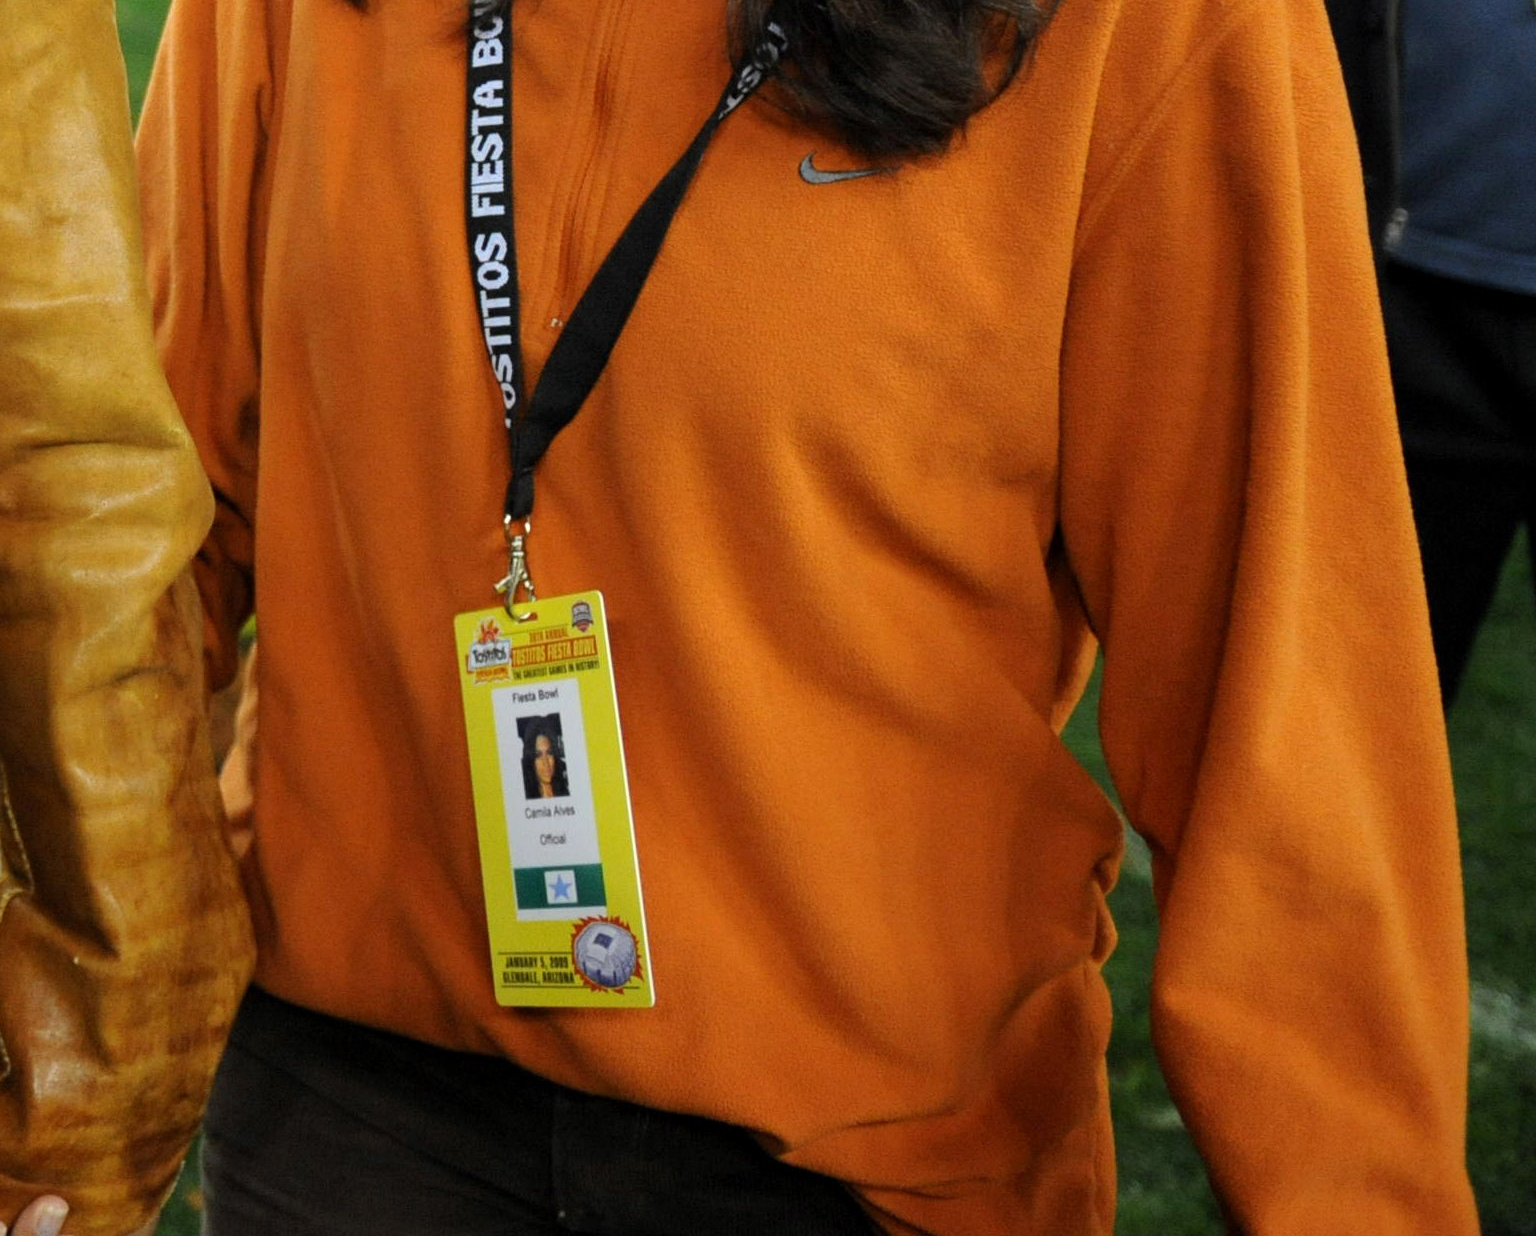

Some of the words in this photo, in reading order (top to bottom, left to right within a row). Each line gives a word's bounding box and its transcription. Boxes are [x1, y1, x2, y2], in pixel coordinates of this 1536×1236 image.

[471, 79, 505, 218] FIESTA
[474, 232, 516, 428] OSTITOS
[513, 645, 546, 666] TOSTITOS
[547, 641, 571, 662] FIESTA
[573, 638, 596, 659] BOWL
[512, 691, 536, 703] Fiesta
[538, 688, 559, 700] Bowl
[525, 807, 552, 819] Camila
[554, 805, 575, 816] Alves
[540, 833, 566, 845] Official
[506, 956, 537, 968] JANUARY
[503, 971, 541, 984] GLENDALE,
[543, 971, 575, 983] ARIZONA
